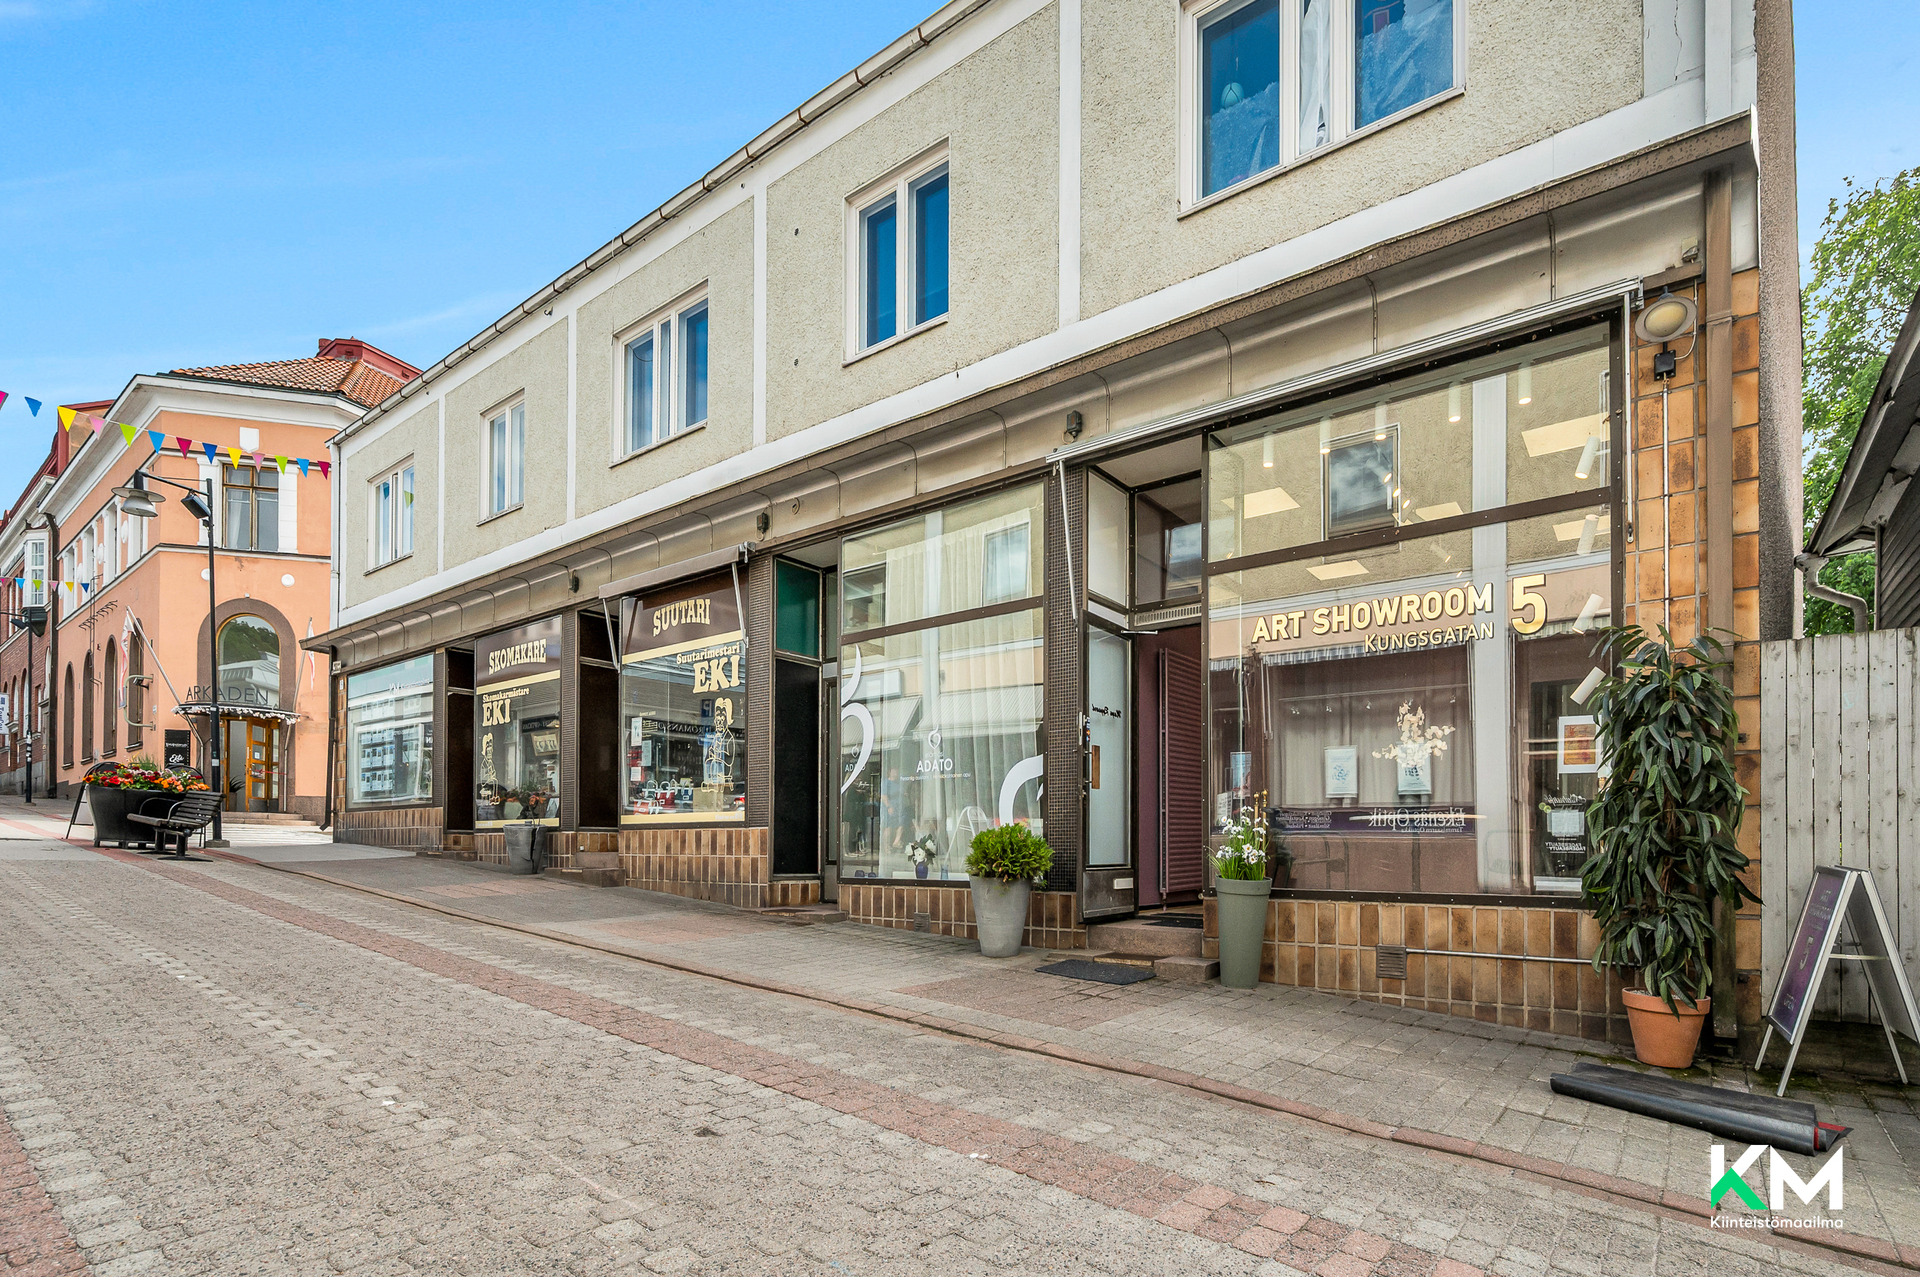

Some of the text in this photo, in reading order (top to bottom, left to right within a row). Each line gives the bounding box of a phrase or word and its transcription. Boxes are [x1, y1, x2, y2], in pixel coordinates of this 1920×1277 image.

[653, 598, 711, 637] SUUTARI
[1251, 582, 1493, 643] ART SHOWROOM
[1511, 573, 1547, 635] 5
[676, 642, 740, 665] Suutarimestari
[1364, 621, 1495, 653] KUNGSGATAN
[488, 638, 547, 676] SKOMAKARE
[692, 655, 740, 694] EKI
[185, 685, 269, 705] ARKADEN
[482, 698, 511, 727] EKI
[916, 758, 953, 773] ADATO
